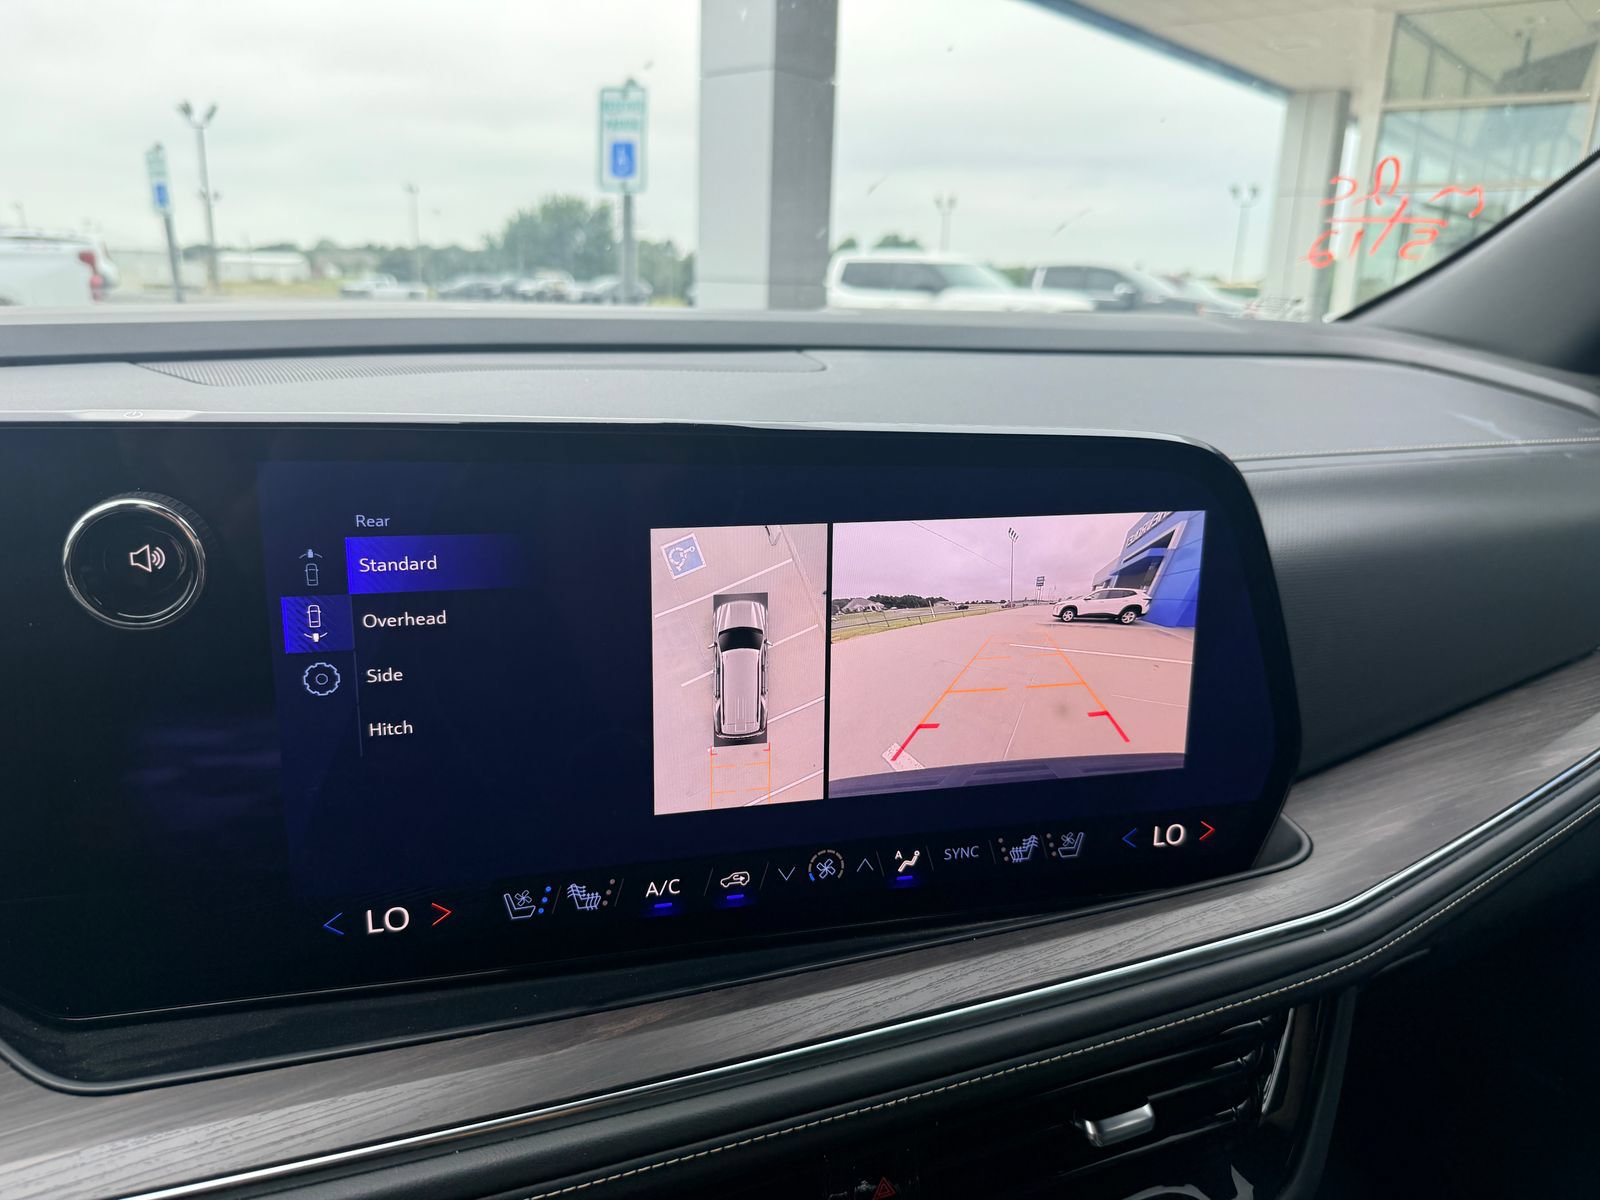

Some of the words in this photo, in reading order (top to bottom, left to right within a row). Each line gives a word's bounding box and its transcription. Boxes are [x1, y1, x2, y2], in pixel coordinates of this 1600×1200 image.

[355, 514, 391, 528] Rear
[358, 554, 438, 573] Standard
[362, 609, 448, 629] Overhead
[365, 666, 404, 683] Side
[368, 720, 414, 737] Hitch
[1152, 822, 1187, 847] LO
[943, 845, 980, 860] SYNC
[645, 878, 681, 898] A/C
[366, 906, 411, 934] LO
